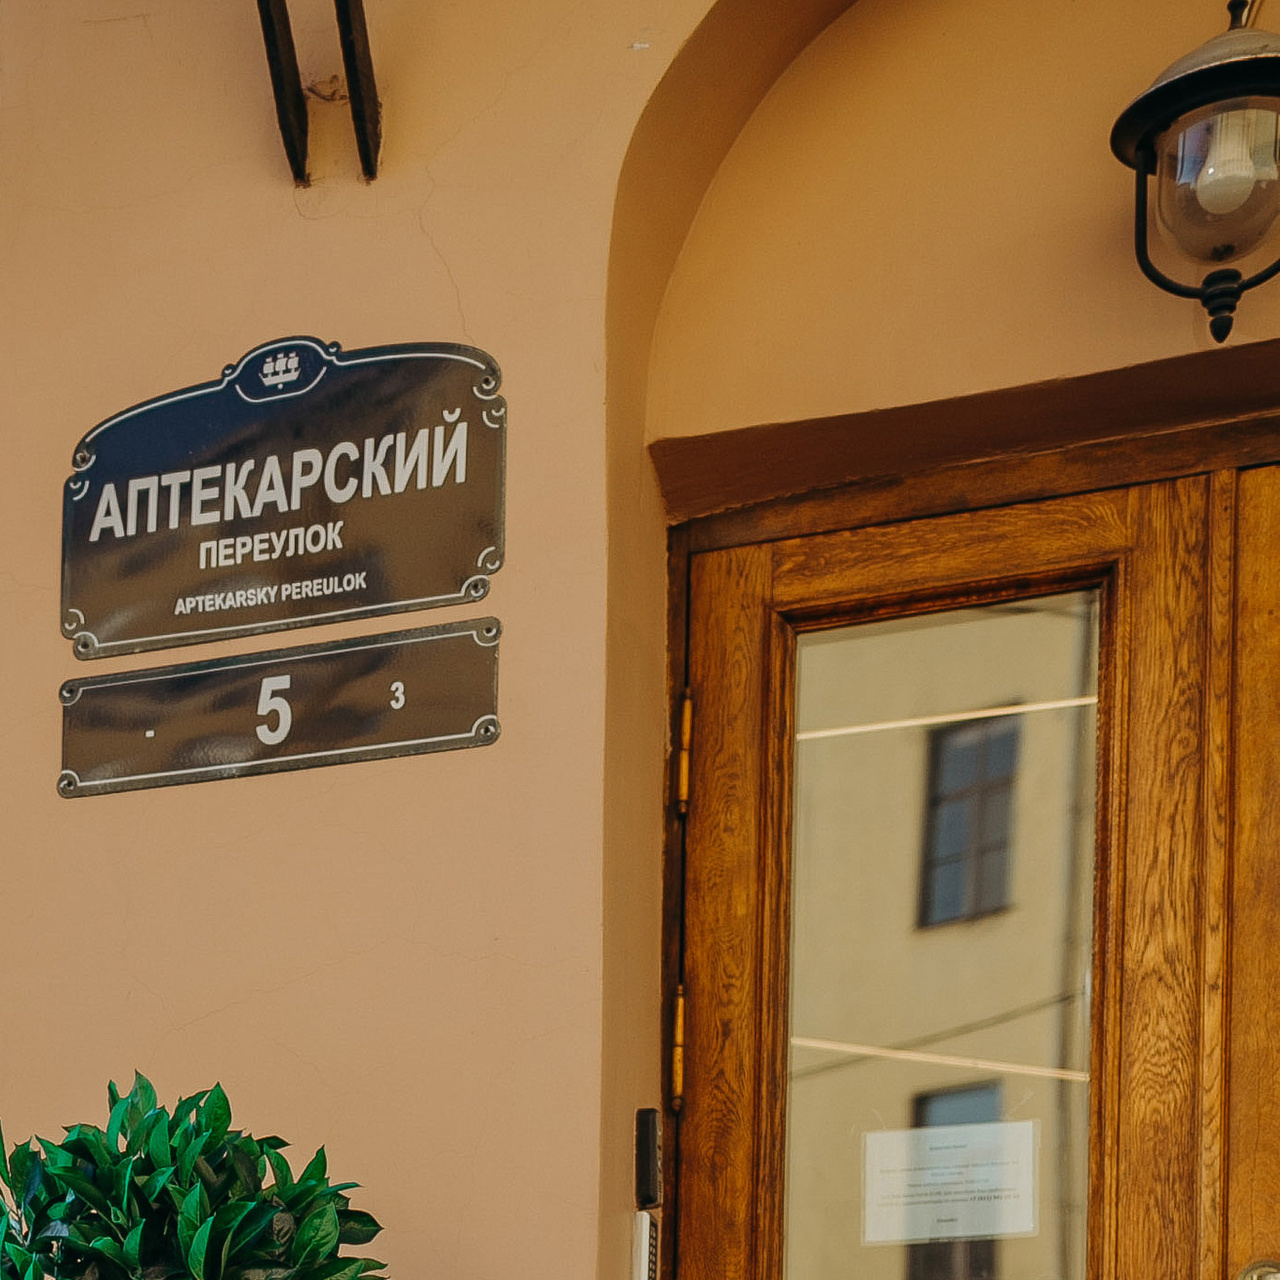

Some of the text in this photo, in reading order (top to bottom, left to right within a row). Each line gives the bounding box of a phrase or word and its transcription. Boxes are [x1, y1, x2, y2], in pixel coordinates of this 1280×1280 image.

[88, 407, 468, 542] АПТЕКАРСКИЙ
[198, 521, 344, 570] ПЕРЕУЛОК
[174, 571, 367, 615] APTEKARSKY PEREULOK
[255, 675, 405, 746] 5 3
